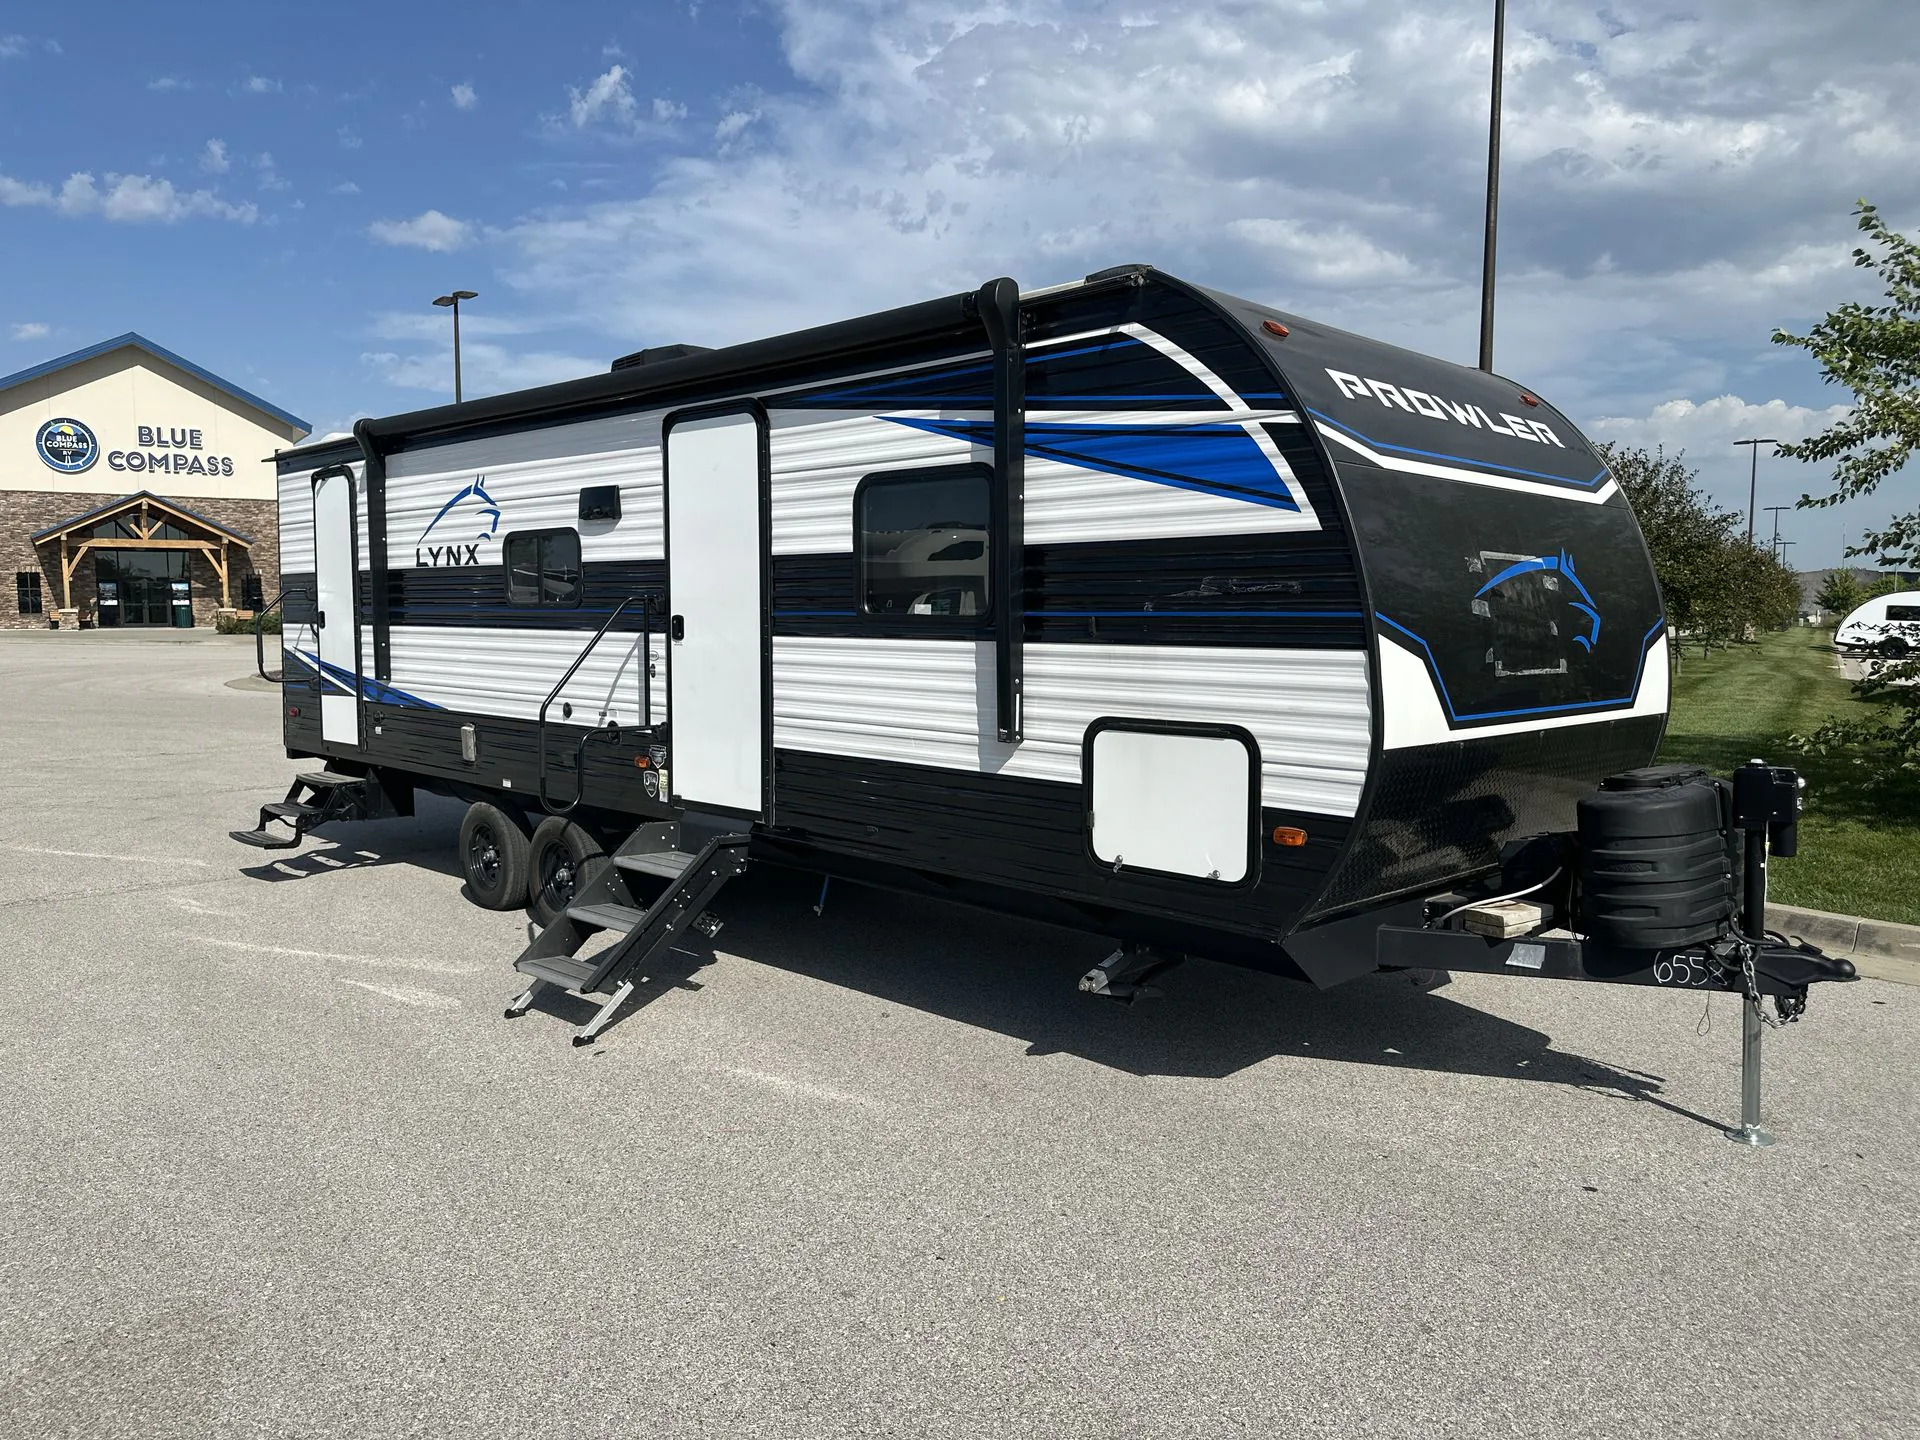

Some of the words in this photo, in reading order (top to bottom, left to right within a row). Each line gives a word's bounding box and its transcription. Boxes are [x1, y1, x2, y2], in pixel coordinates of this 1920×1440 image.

[1324, 368, 1566, 448] PROWLER
[46, 441, 88, 449] COMPASS
[56, 435, 78, 443] BLUE
[138, 426, 203, 449] BLUE
[108, 450, 234, 476] COMPASS
[416, 543, 480, 567] LYNX
[1653, 950, 1728, 986] 6558
